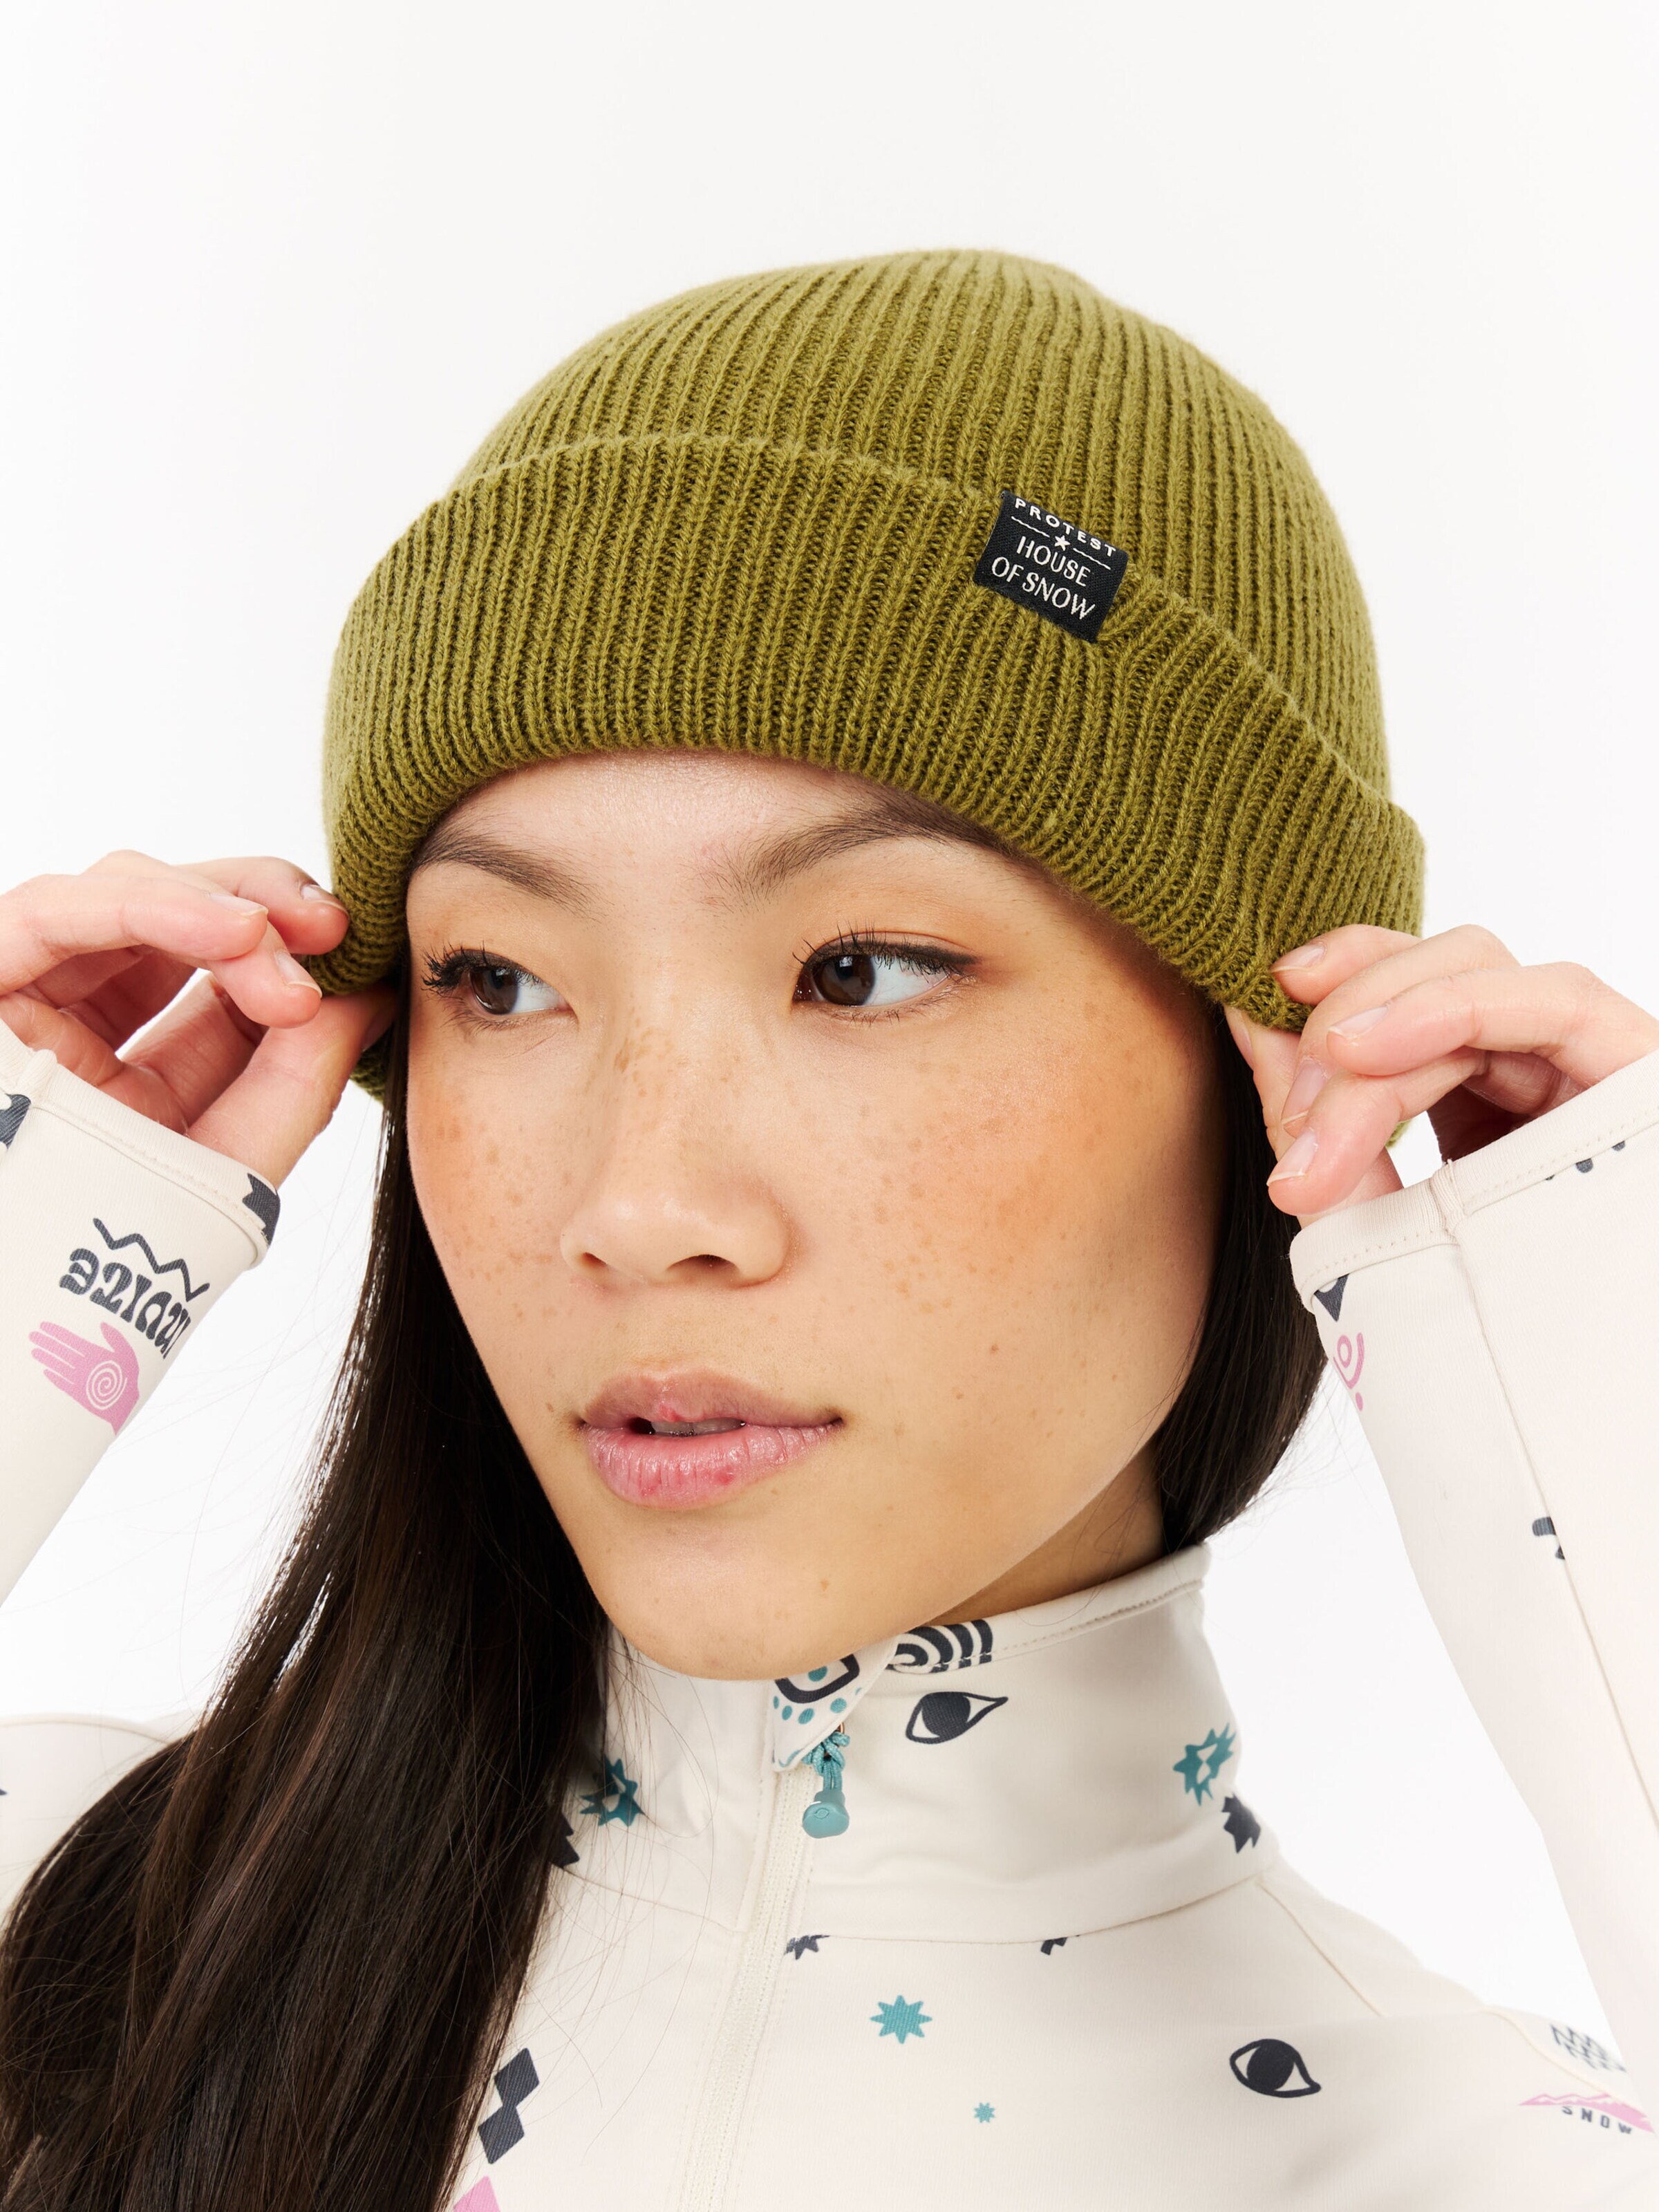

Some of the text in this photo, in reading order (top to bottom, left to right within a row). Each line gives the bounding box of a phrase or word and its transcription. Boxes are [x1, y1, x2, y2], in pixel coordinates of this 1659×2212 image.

[1015, 498, 1116, 556] PROTEST
[991, 556, 1096, 619] OF SNOW
[1016, 536, 1090, 587] HOUSE
[1562, 2106, 1632, 2135] SNOW
